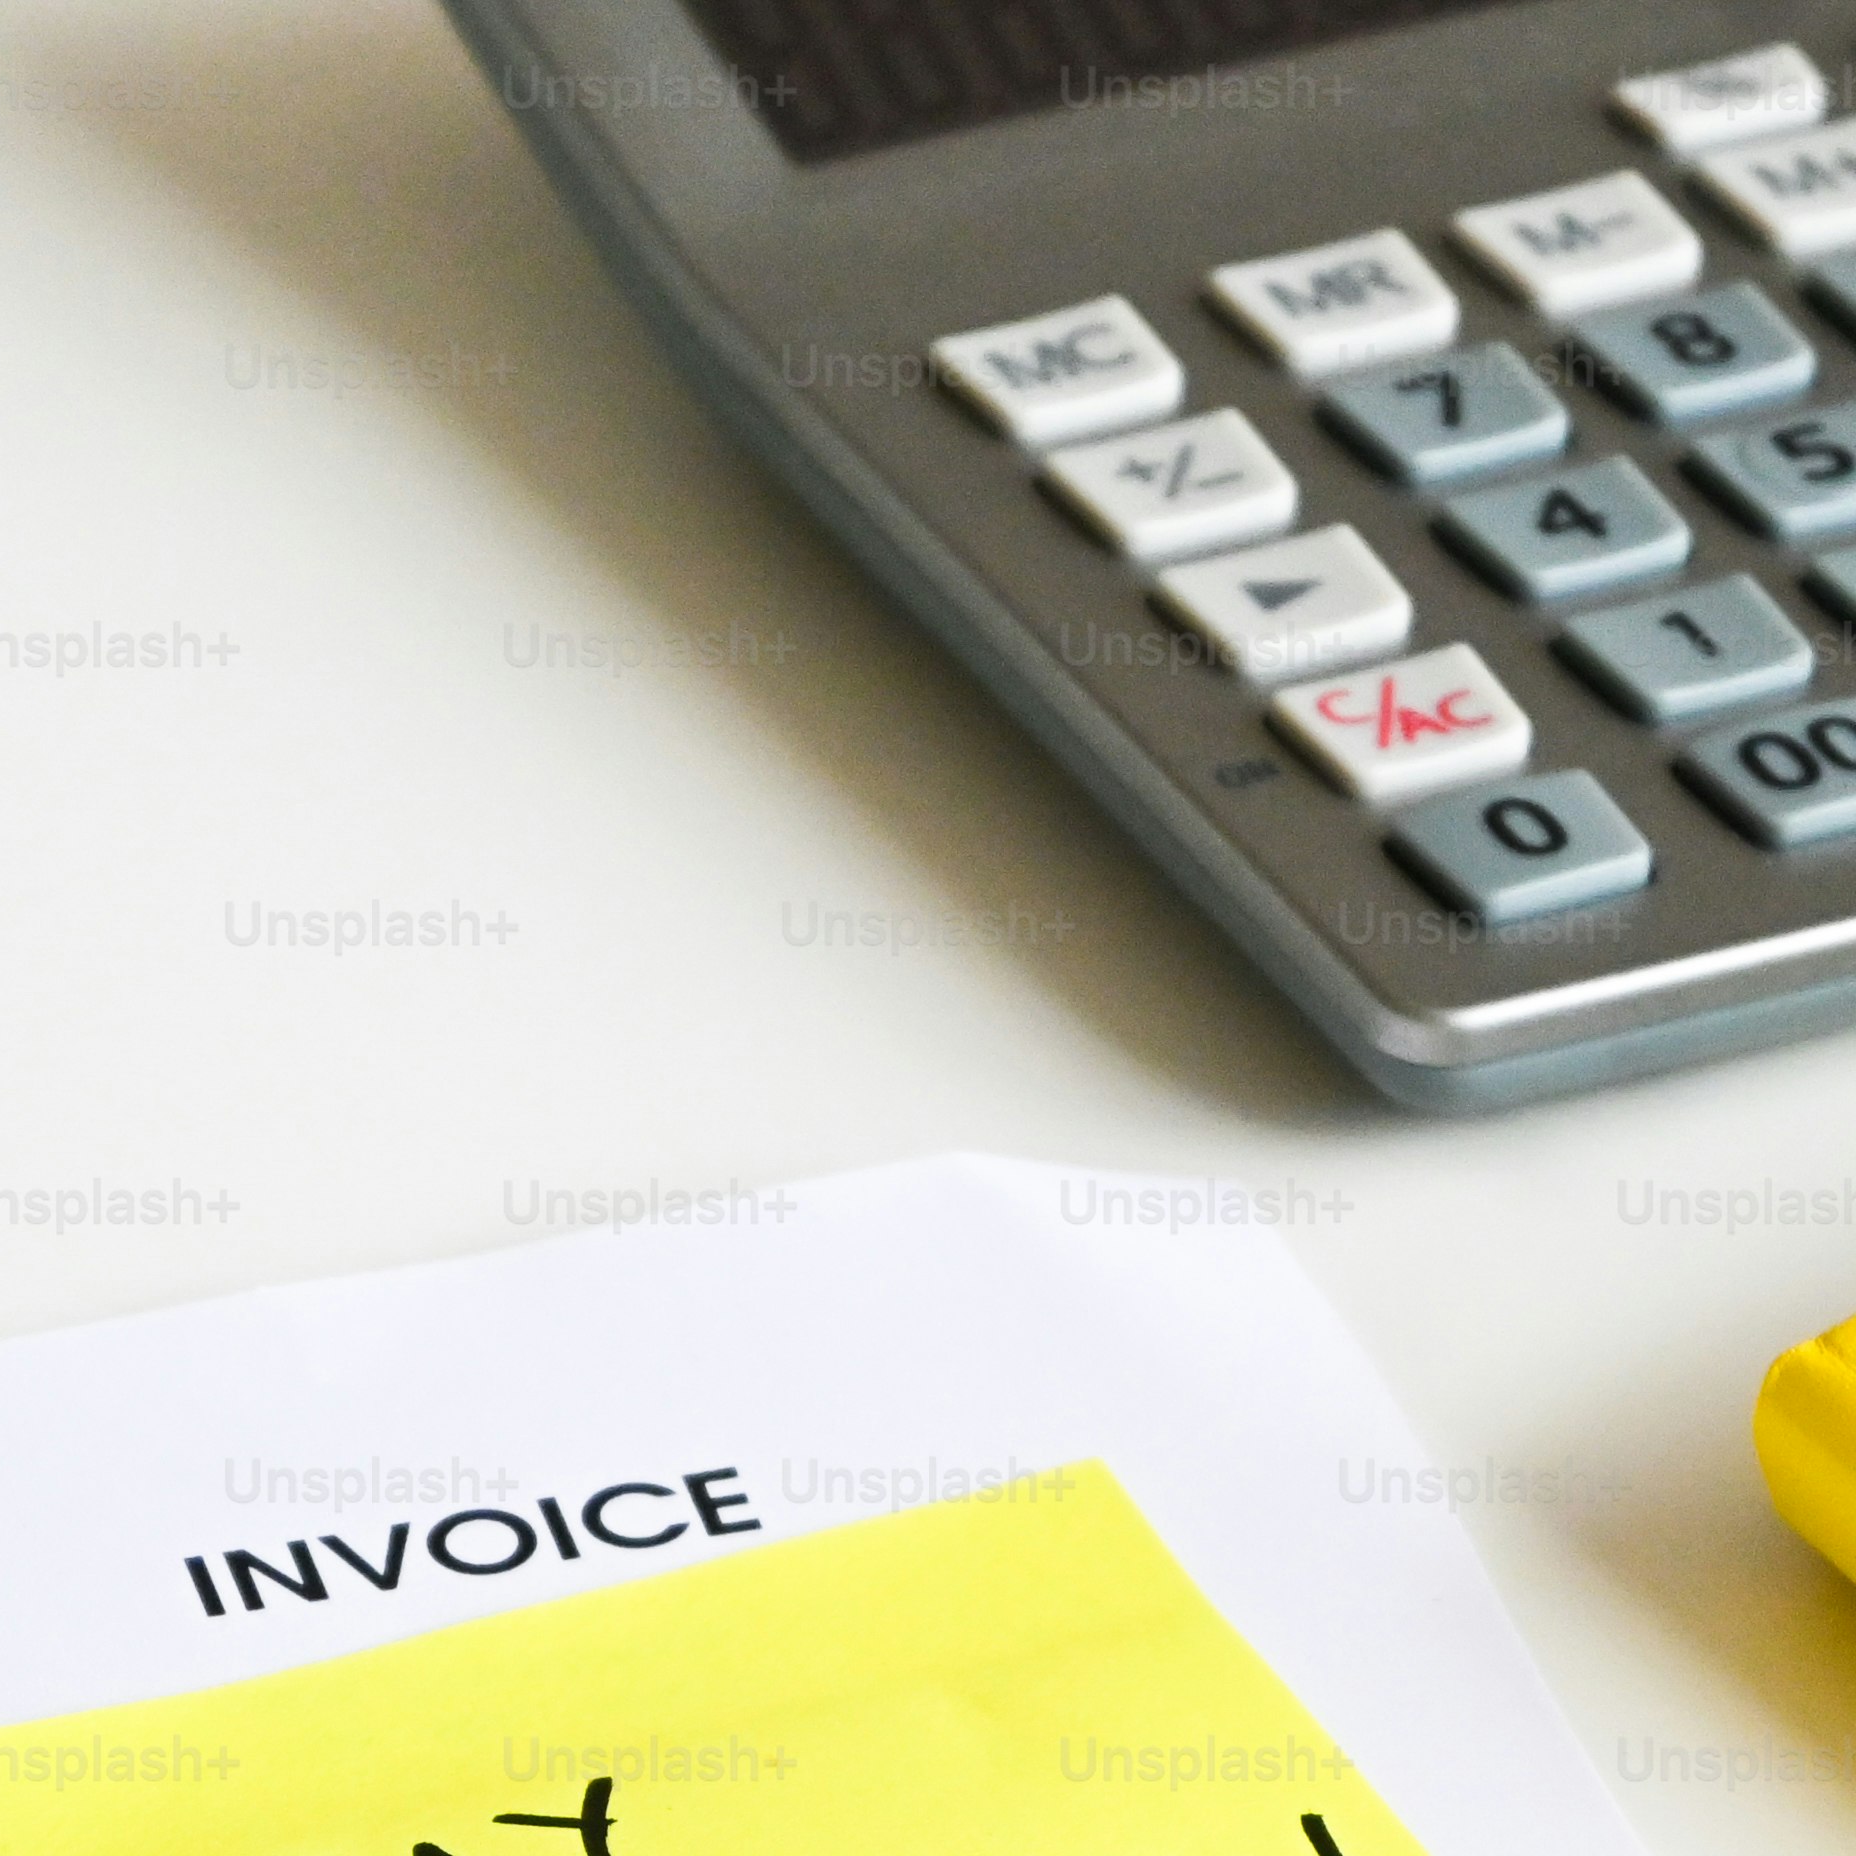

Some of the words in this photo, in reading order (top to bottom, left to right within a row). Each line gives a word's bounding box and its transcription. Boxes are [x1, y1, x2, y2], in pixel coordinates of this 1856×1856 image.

[1264, 256, 1406, 318] MR
[982, 320, 1138, 390] MC
[1650, 311, 1738, 369] 8
[1392, 369, 1466, 430] 7
[1535, 486, 1611, 539] 4
[1659, 609, 1721, 659] 1
[1480, 796, 1574, 858] 0
[183, 1465, 763, 1618] INVOICE
